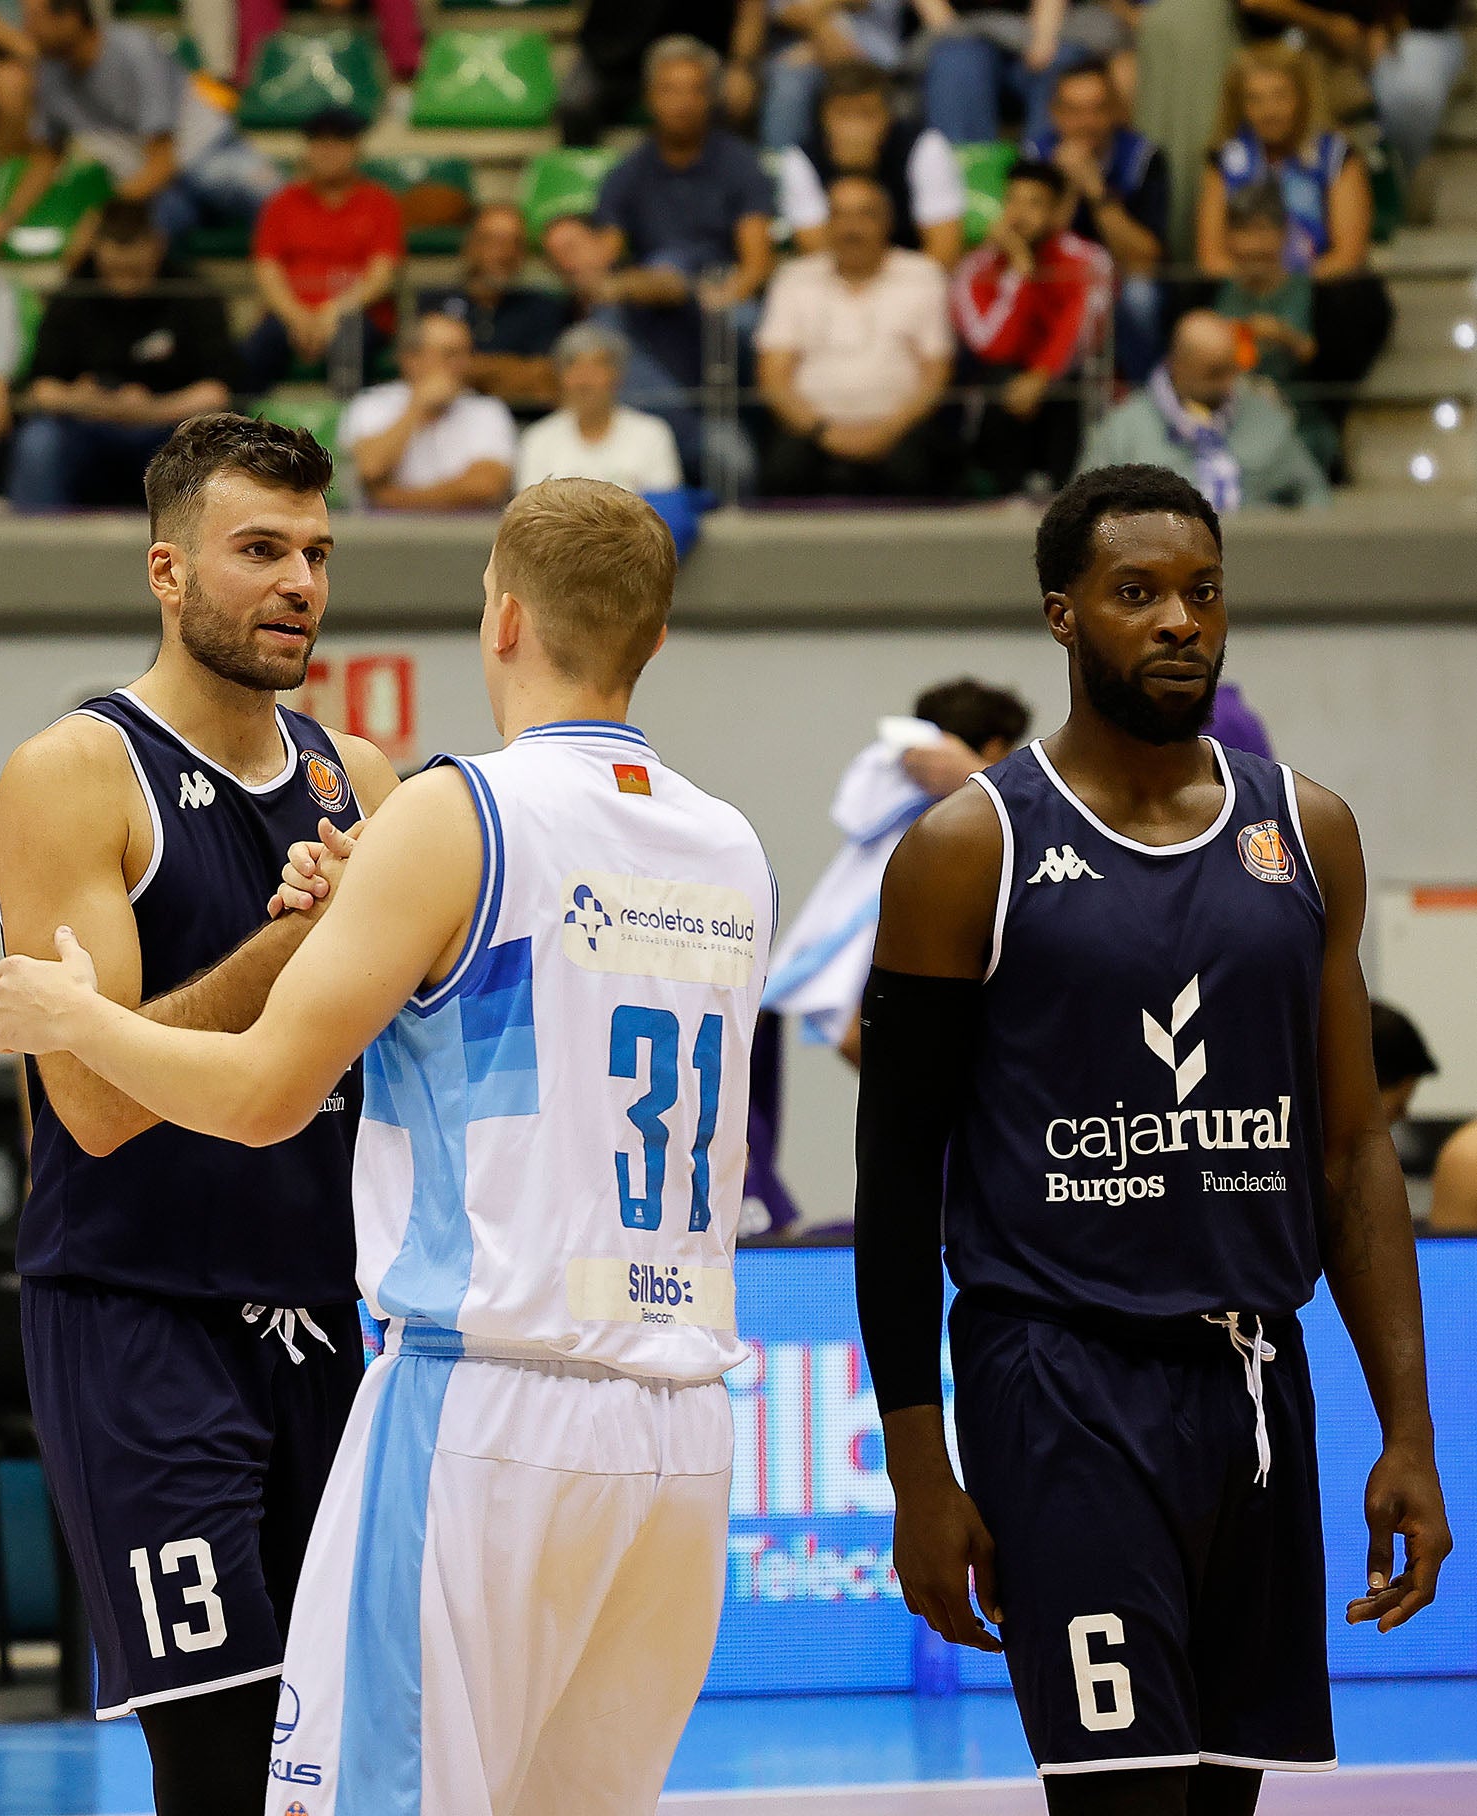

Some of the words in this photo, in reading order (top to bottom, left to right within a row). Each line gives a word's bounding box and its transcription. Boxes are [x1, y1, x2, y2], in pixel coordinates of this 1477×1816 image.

[620, 906, 704, 933] recoletas
[711, 915, 754, 942] salud
[608, 1004, 723, 1232] 31
[1045, 1096, 1291, 1171] cajarural
[1045, 1173, 1165, 1206] Burgos
[641, 1307, 676, 1324] Telecom
[129, 1537, 227, 1658] 13
[1068, 1613, 1135, 1731] 6
